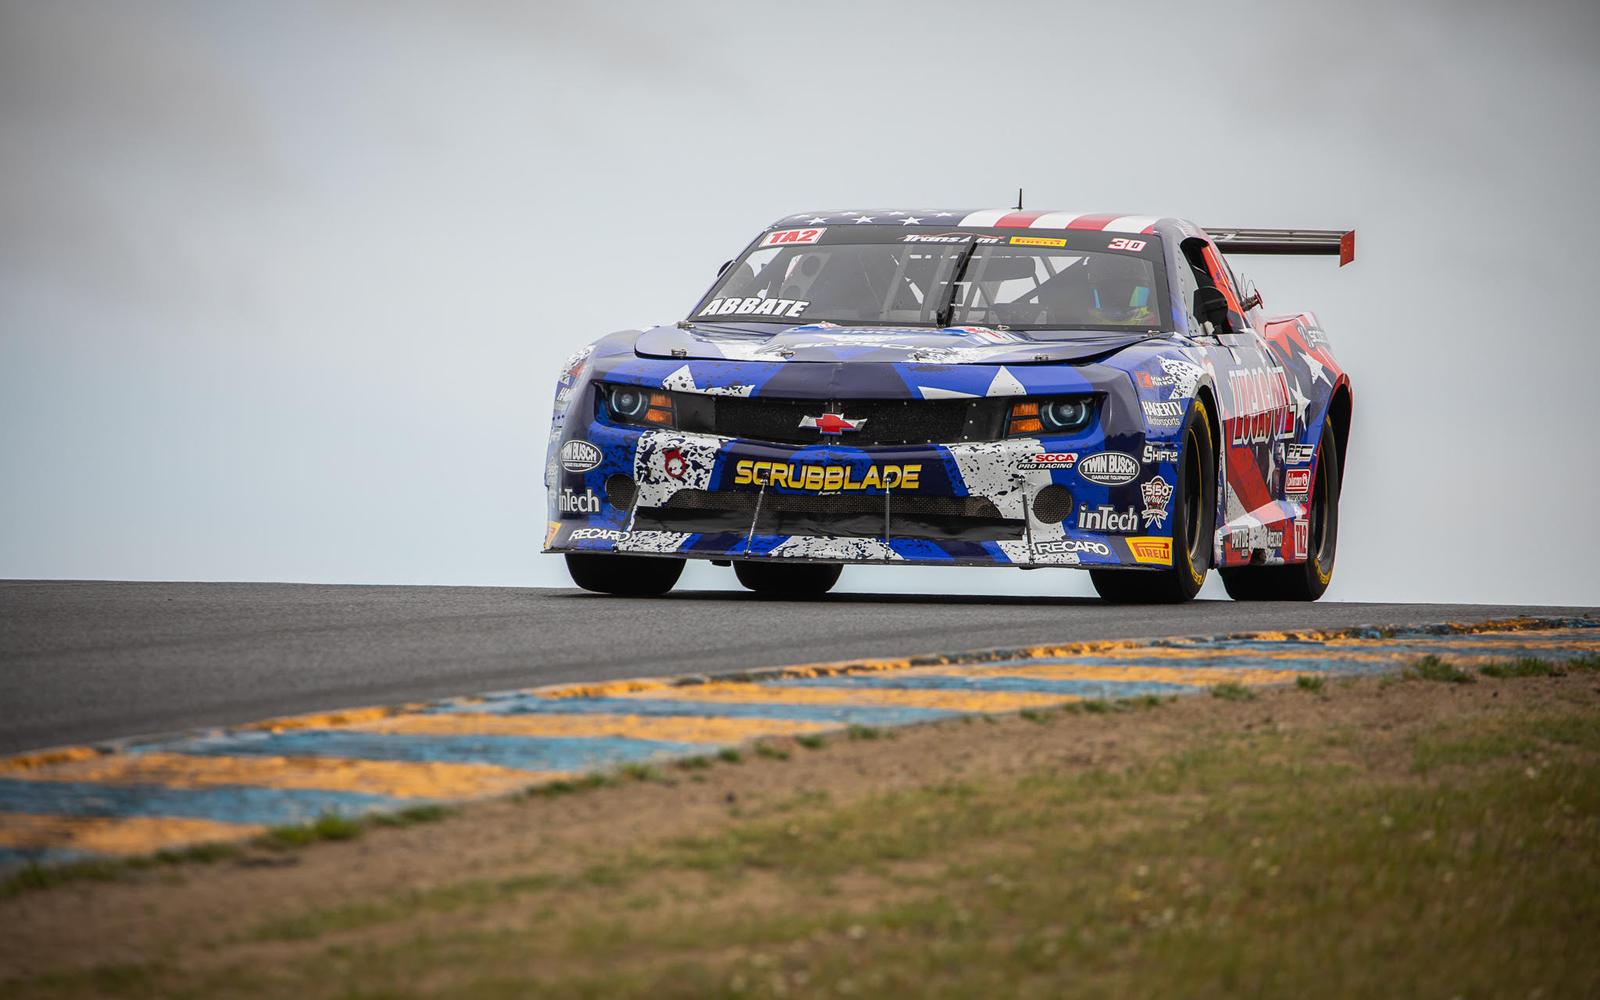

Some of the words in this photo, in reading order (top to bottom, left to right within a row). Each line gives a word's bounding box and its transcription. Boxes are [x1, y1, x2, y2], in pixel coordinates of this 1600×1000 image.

[770, 230, 818, 244] TA2
[1107, 237, 1147, 252] 30
[698, 297, 809, 318] ABBATE
[1141, 401, 1183, 416] HAGERTY
[572, 443, 597, 461] BUSCH
[1035, 454, 1075, 462] SCCA
[1083, 455, 1108, 473] TWIN
[1108, 455, 1136, 473] BUSCH
[735, 460, 922, 490] SCRUBBLADE
[1145, 484, 1169, 496] 5150
[558, 488, 600, 512] inTech
[1078, 503, 1138, 531] inTech
[568, 529, 630, 542] RECARO
[1037, 541, 1110, 556] RECARO
[1132, 542, 1170, 560] PIRELLI
